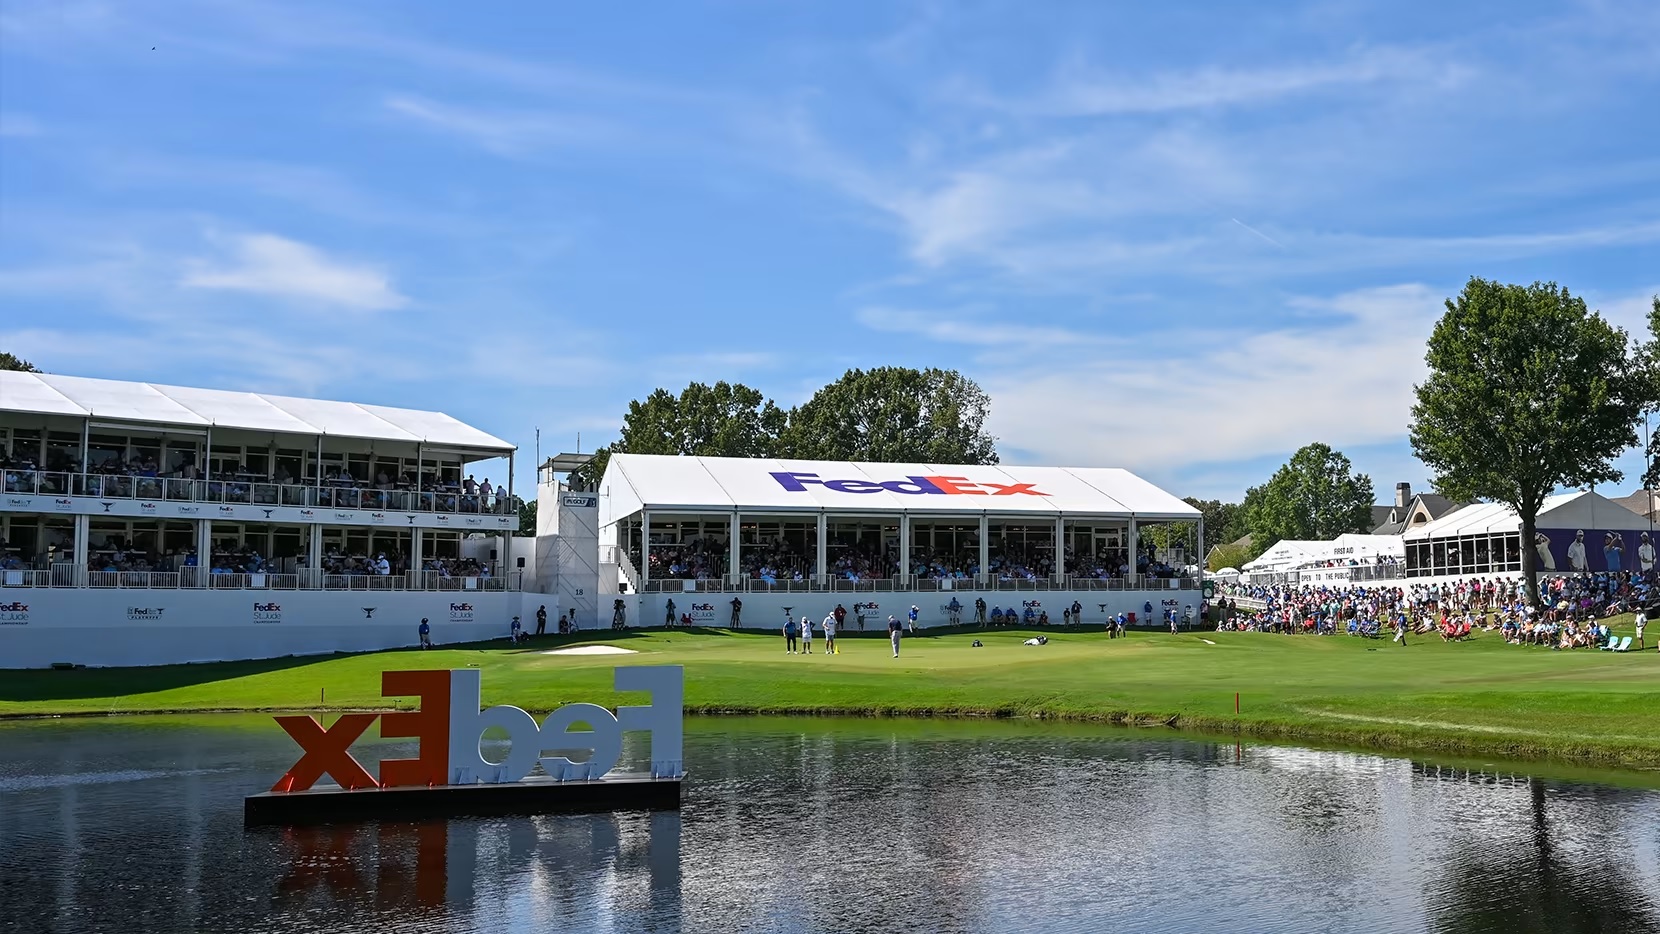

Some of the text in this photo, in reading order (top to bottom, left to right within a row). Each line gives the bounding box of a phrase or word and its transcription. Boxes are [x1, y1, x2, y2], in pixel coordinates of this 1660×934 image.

[768, 472, 1054, 497] FedEx
[253, 602, 281, 611] FedEx
[450, 602, 473, 611] FedEx
[691, 603, 714, 611] FedEx
